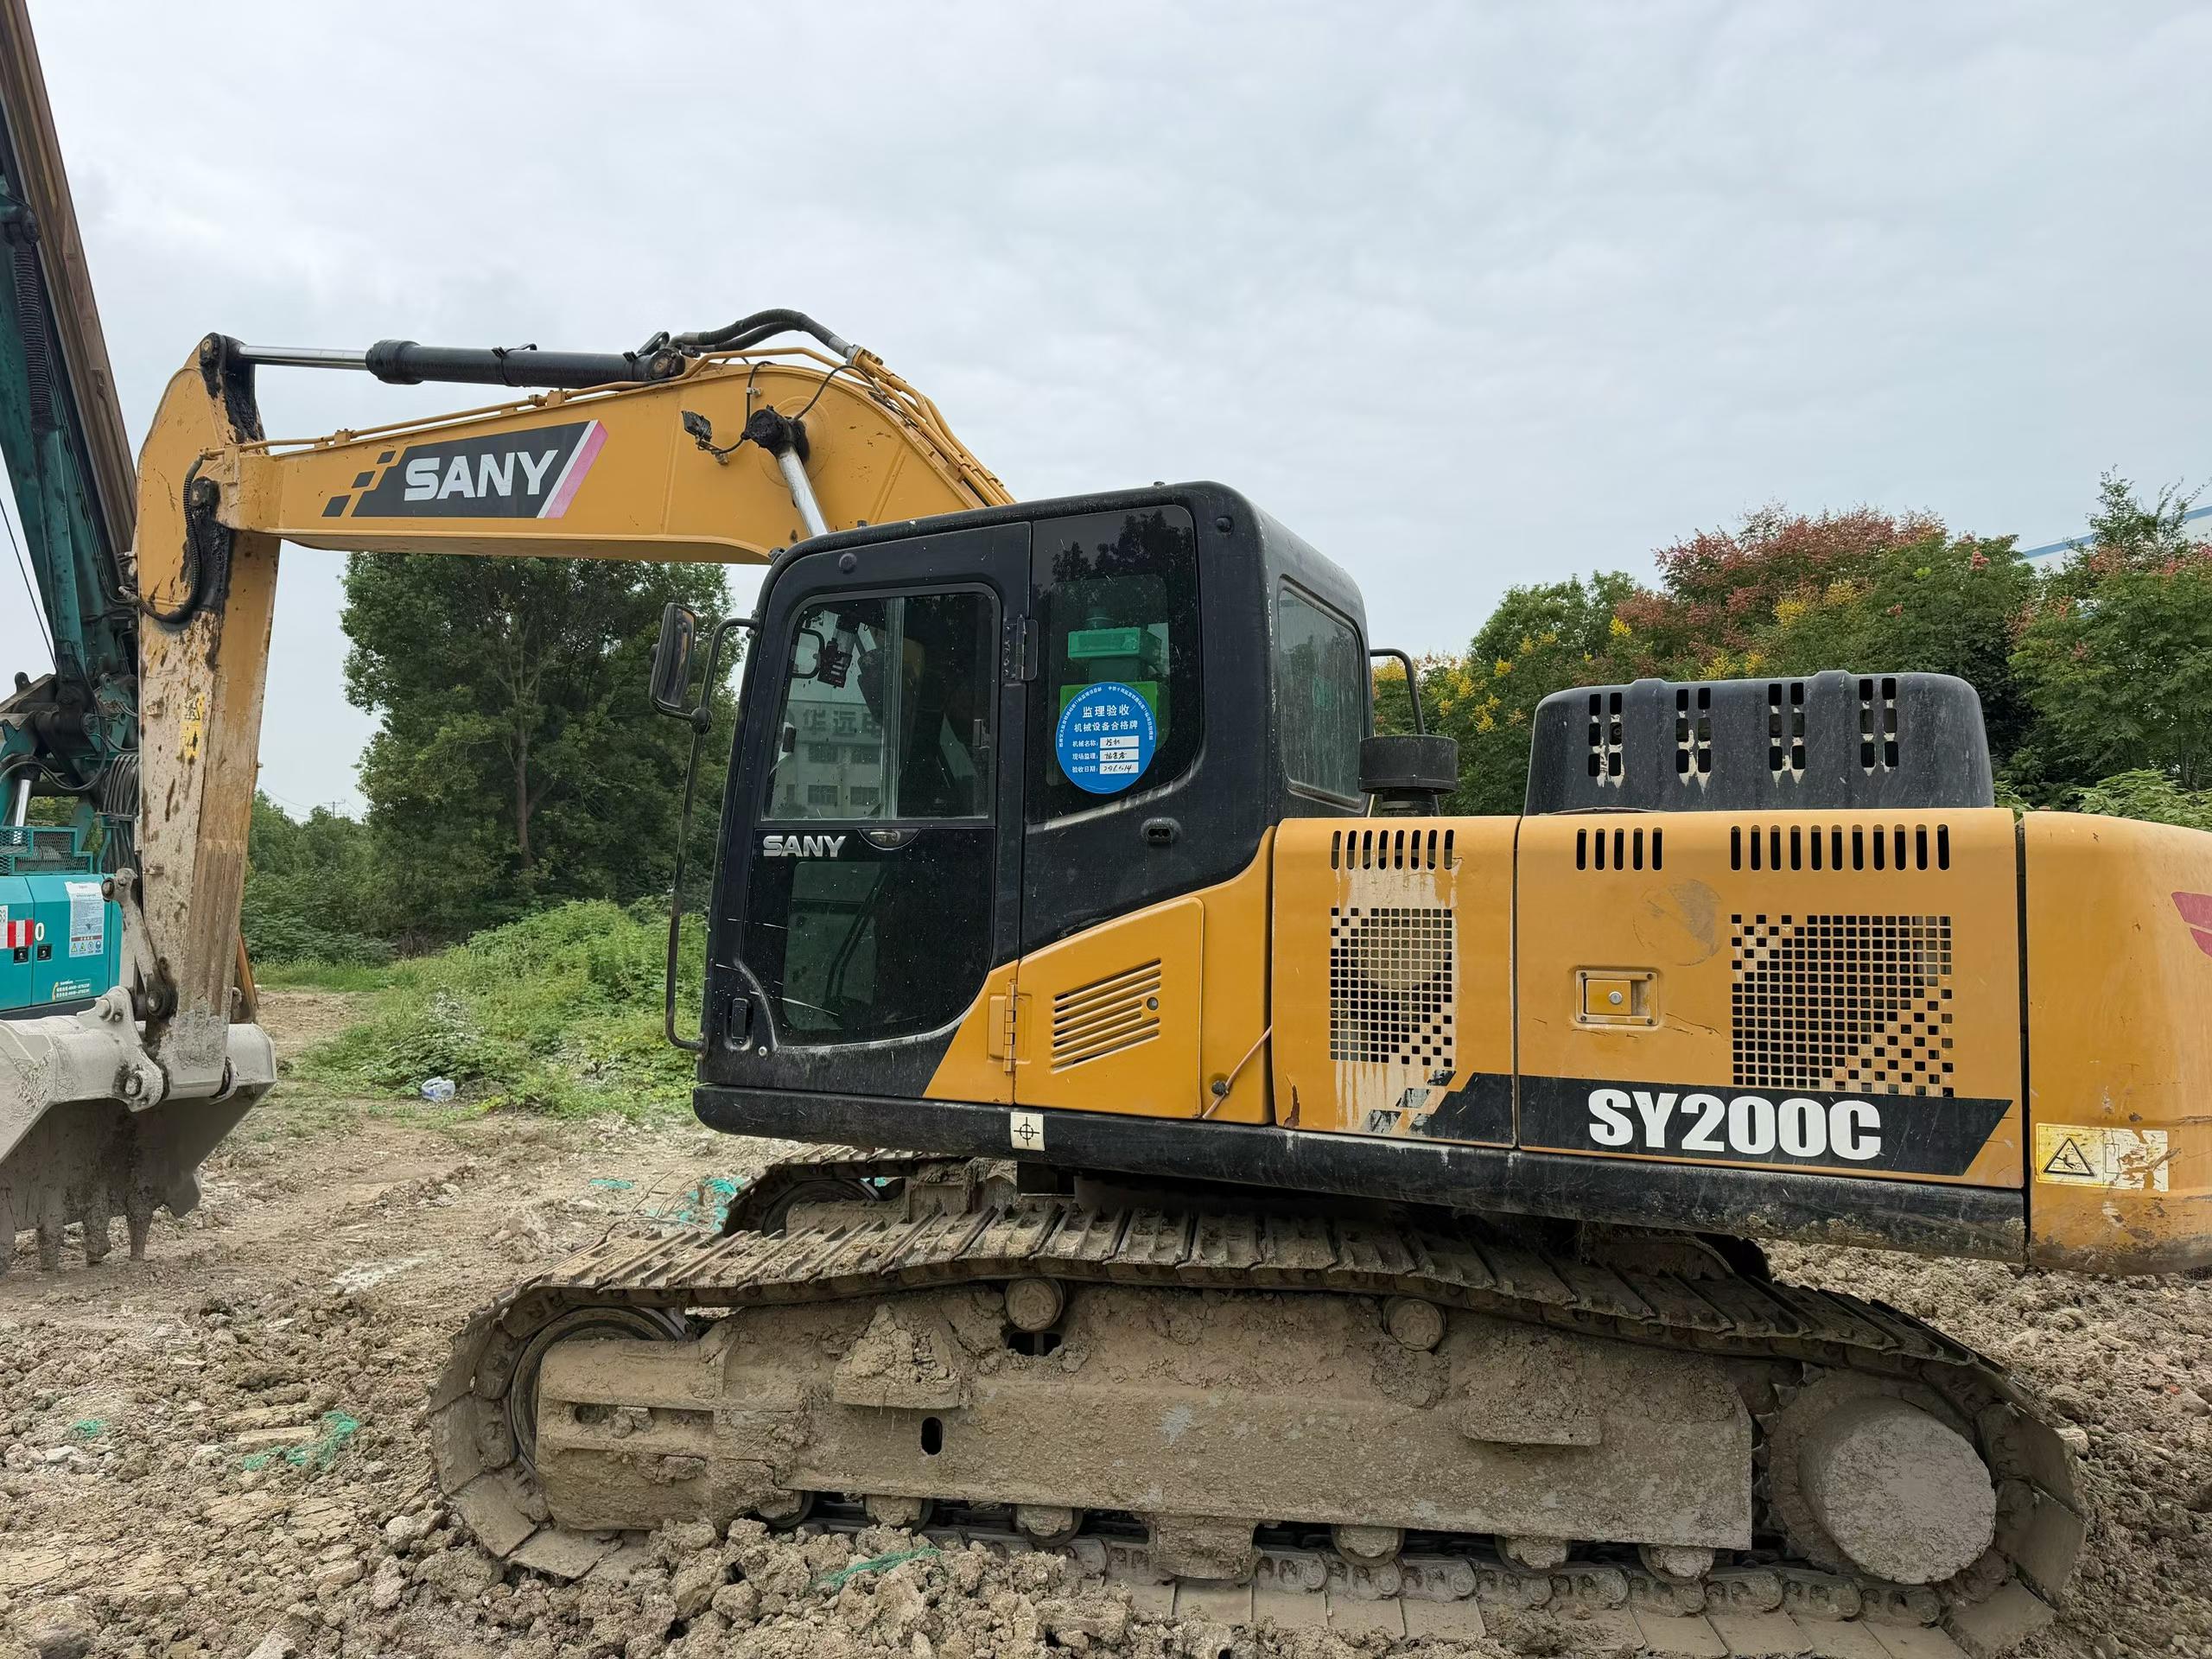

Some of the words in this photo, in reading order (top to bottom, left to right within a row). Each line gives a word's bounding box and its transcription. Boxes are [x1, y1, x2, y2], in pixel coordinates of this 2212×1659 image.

[404, 449, 559, 501] SANY
[1082, 704, 1130, 718] 监理验收
[1073, 720, 1138, 733] 机械设备合格牌
[763, 835, 847, 858] SANY
[1587, 1089, 1882, 1160] SY200C
